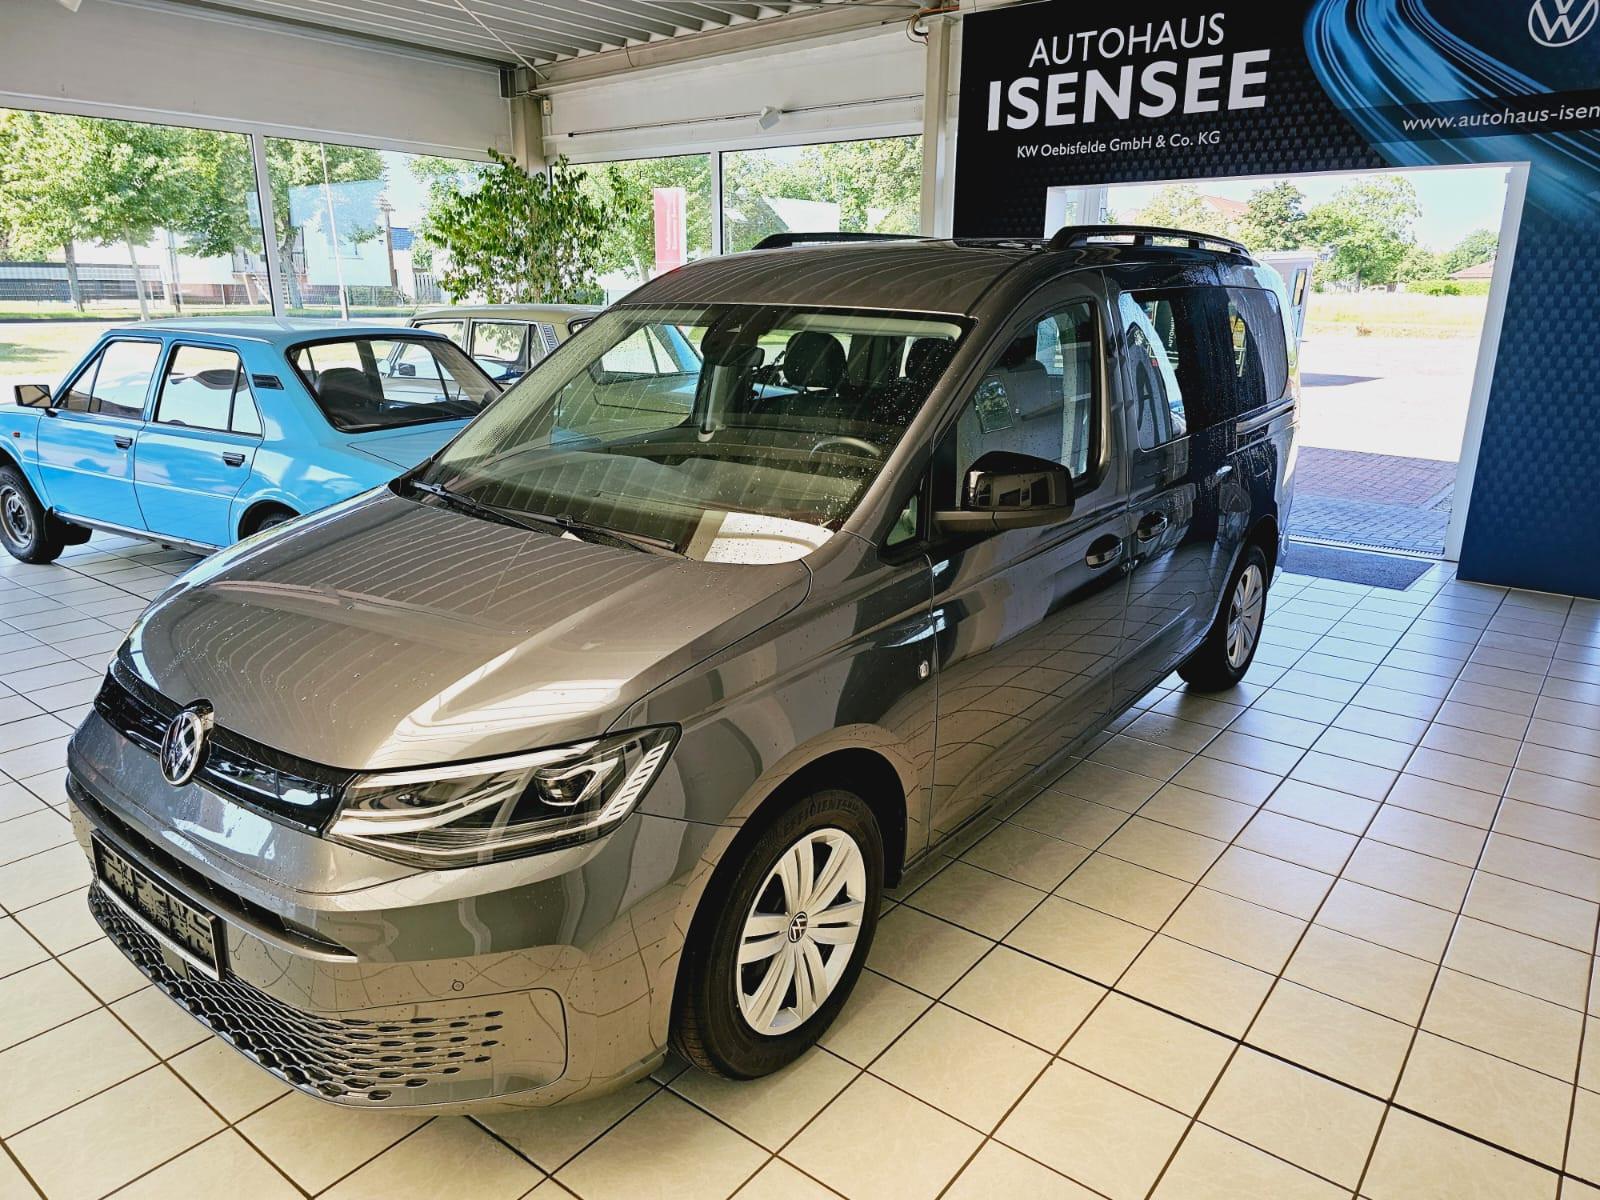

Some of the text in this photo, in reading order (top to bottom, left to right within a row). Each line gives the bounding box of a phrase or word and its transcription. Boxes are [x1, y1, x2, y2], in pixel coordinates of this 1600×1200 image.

[1028, 12, 1225, 68] AUTOHAUS
[987, 48, 1270, 132] ISENSEE
[1402, 105, 1600, 131] www.autohaus-isen
[1016, 130, 1221, 159] KW Oebisfelde GmbH & Co. KG
